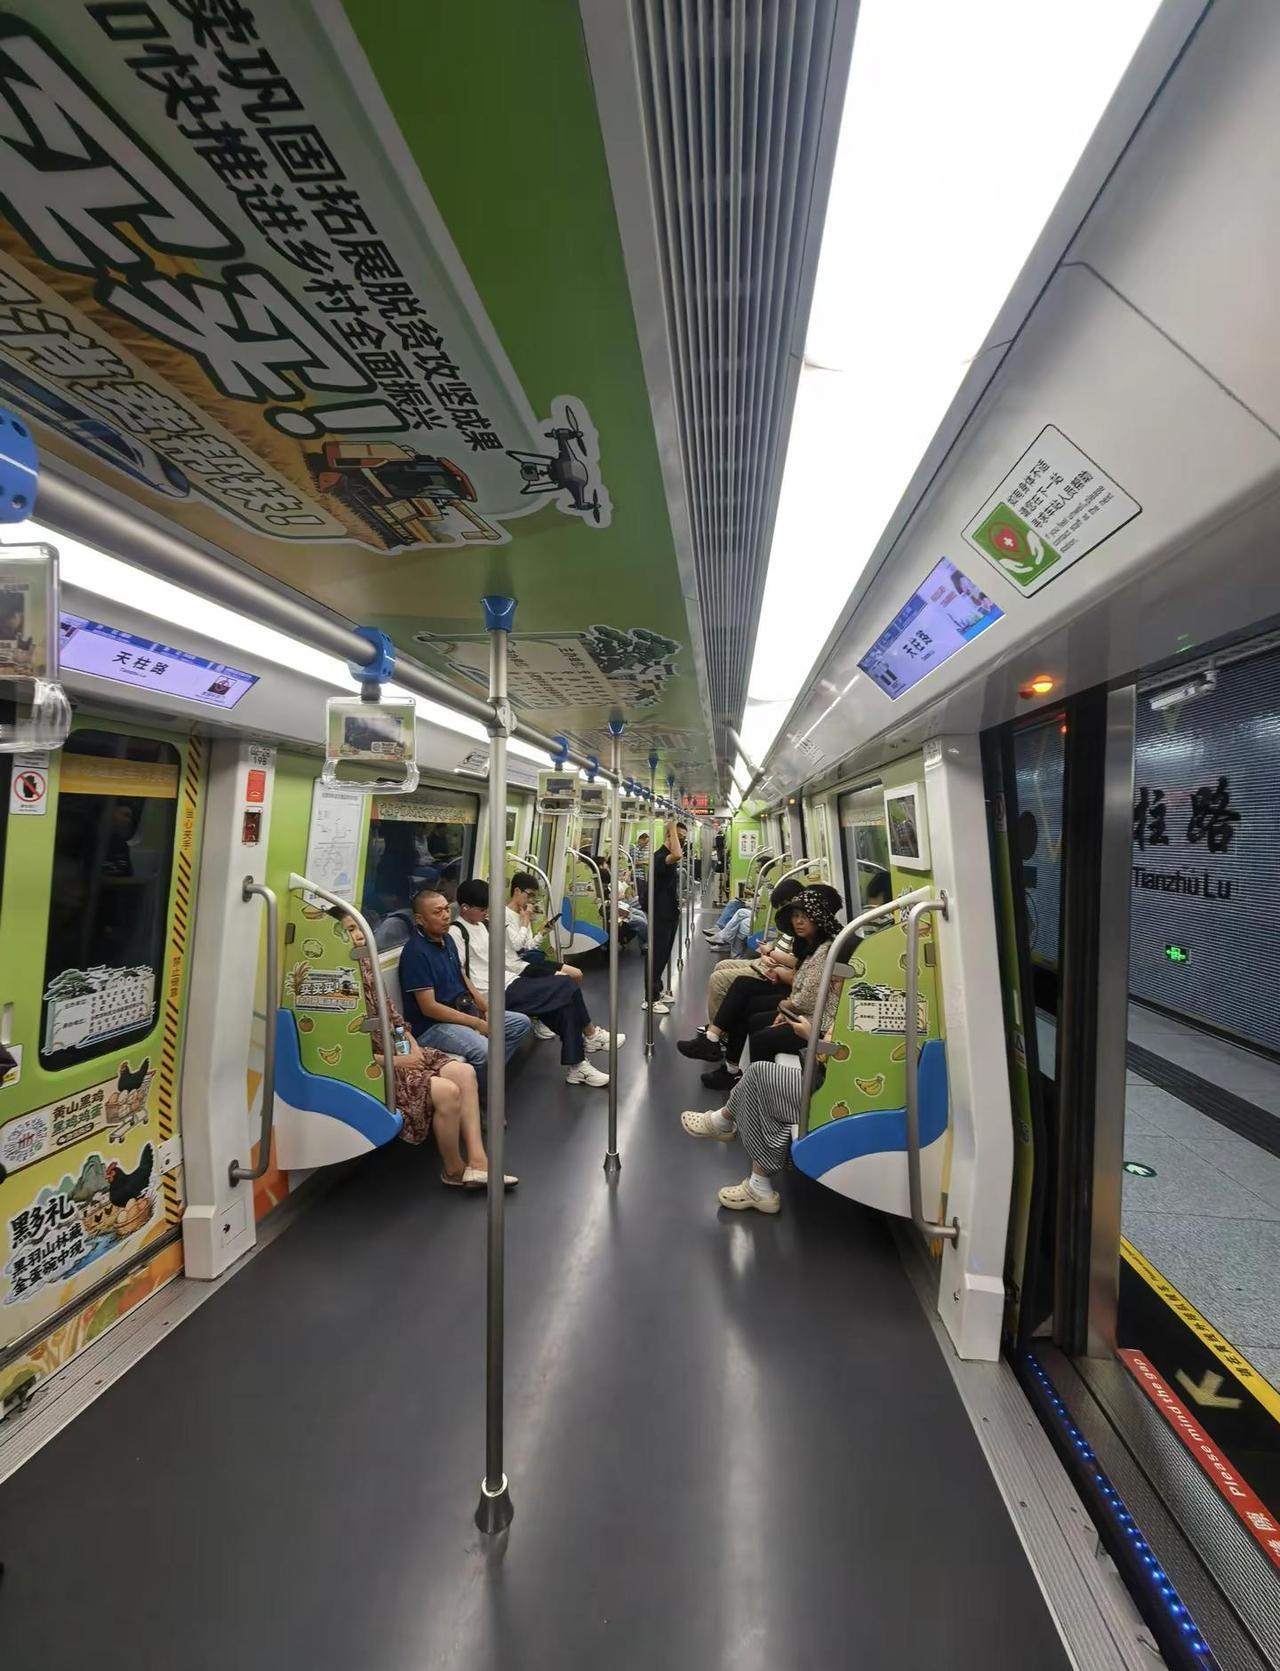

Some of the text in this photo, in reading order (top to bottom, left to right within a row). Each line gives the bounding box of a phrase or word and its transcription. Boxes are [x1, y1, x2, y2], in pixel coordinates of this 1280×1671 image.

[112, 650, 169, 676] 天柱路
[52, 1089, 104, 1122] 黄山黑鸡
[1133, 1357, 1157, 1381] gap
[1151, 1382, 1170, 1405] the
[1167, 1405, 1203, 1441] mind
[1200, 1444, 1246, 1498] Please
